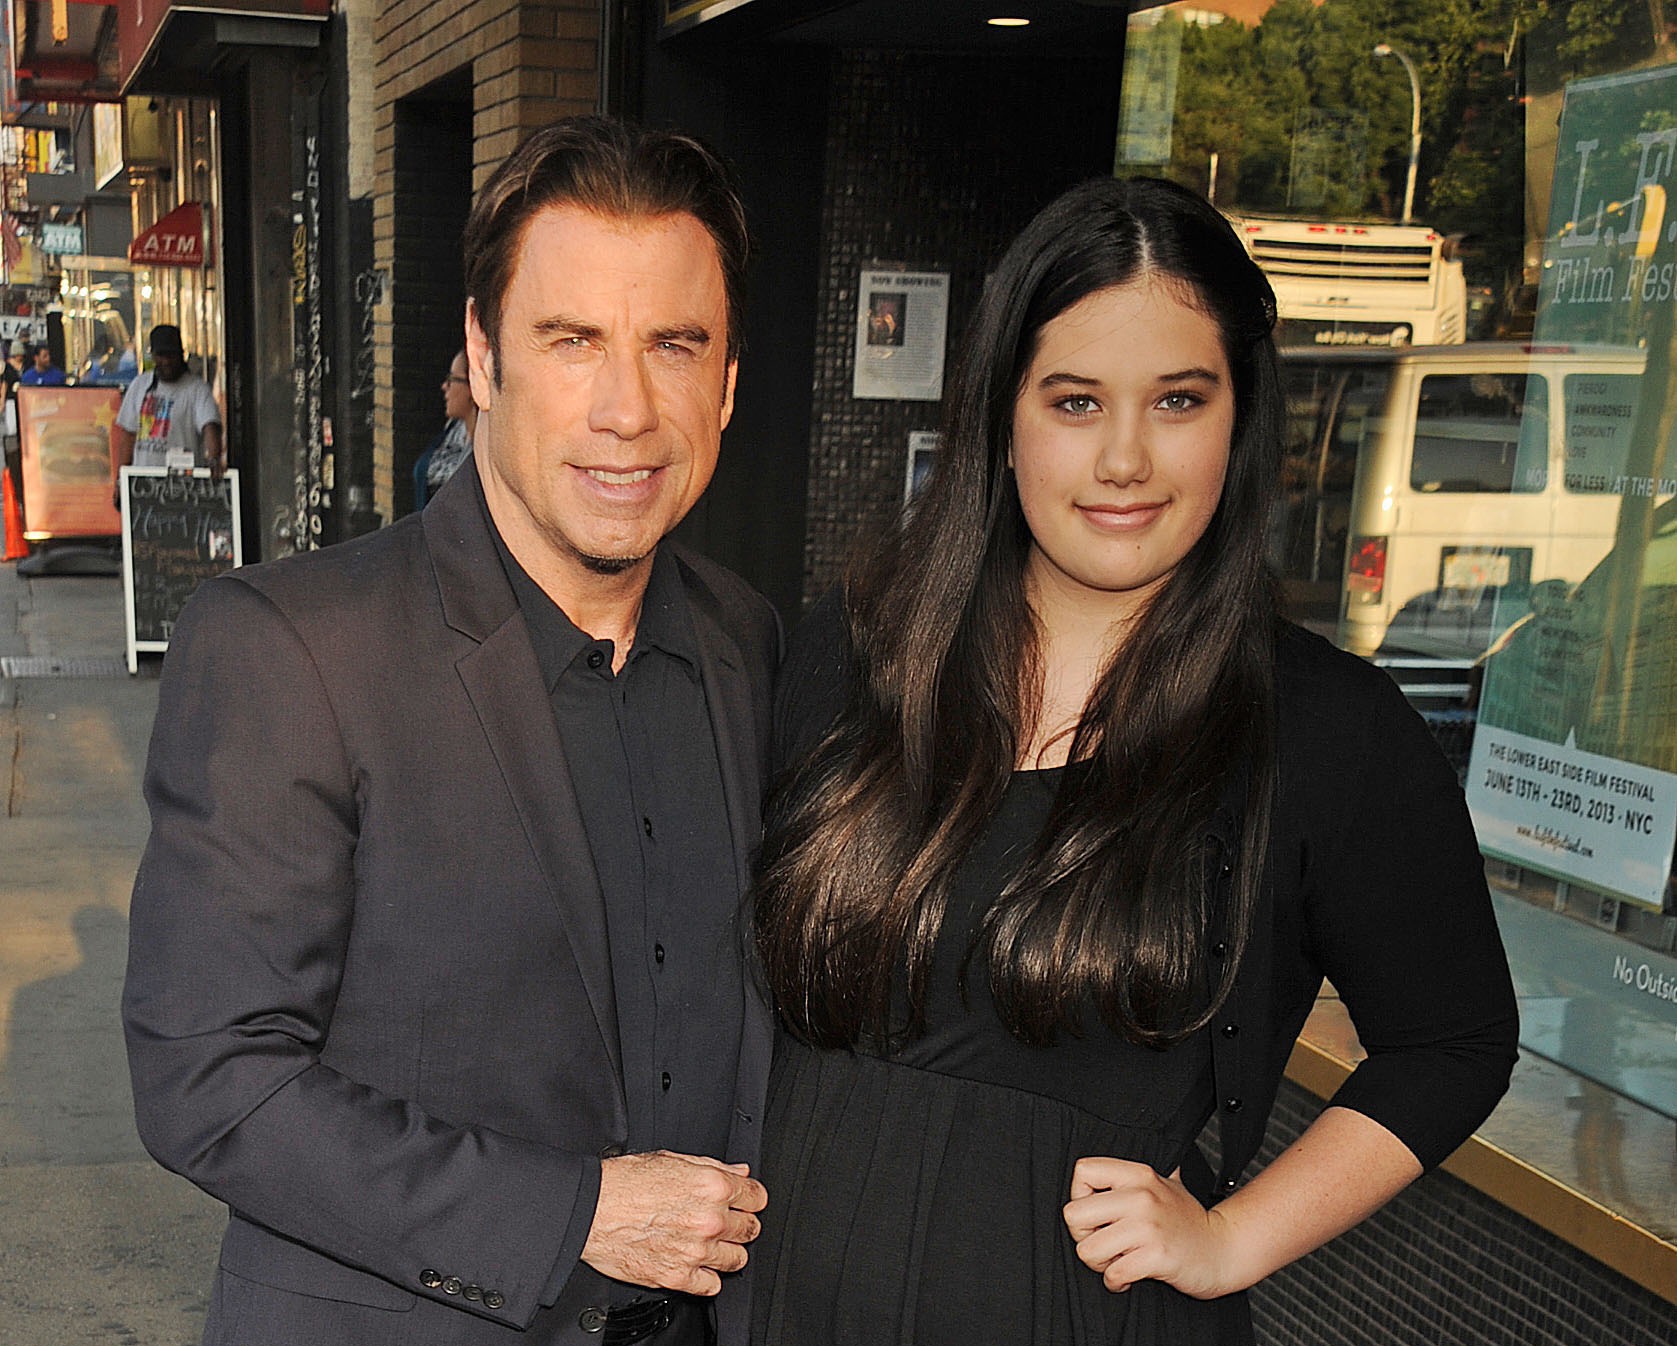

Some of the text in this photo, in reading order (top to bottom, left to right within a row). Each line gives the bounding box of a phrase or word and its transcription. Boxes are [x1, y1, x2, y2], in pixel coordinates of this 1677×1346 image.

[144, 233, 196, 253] ATM
[1552, 257, 1613, 303] Film
[1612, 475, 1630, 495] AT
[1632, 477, 1654, 496] THE
[1489, 743, 1655, 802] THE LOWER EAST SIDE FILM FESTIVAL
[1484, 769, 1514, 794] JUNE
[1516, 776, 1541, 801] 13TH
[1551, 789, 1584, 818] 23RD,
[1587, 800, 1615, 824] 2013
[1624, 810, 1653, 835] NYC
[1613, 955, 1633, 984] No
